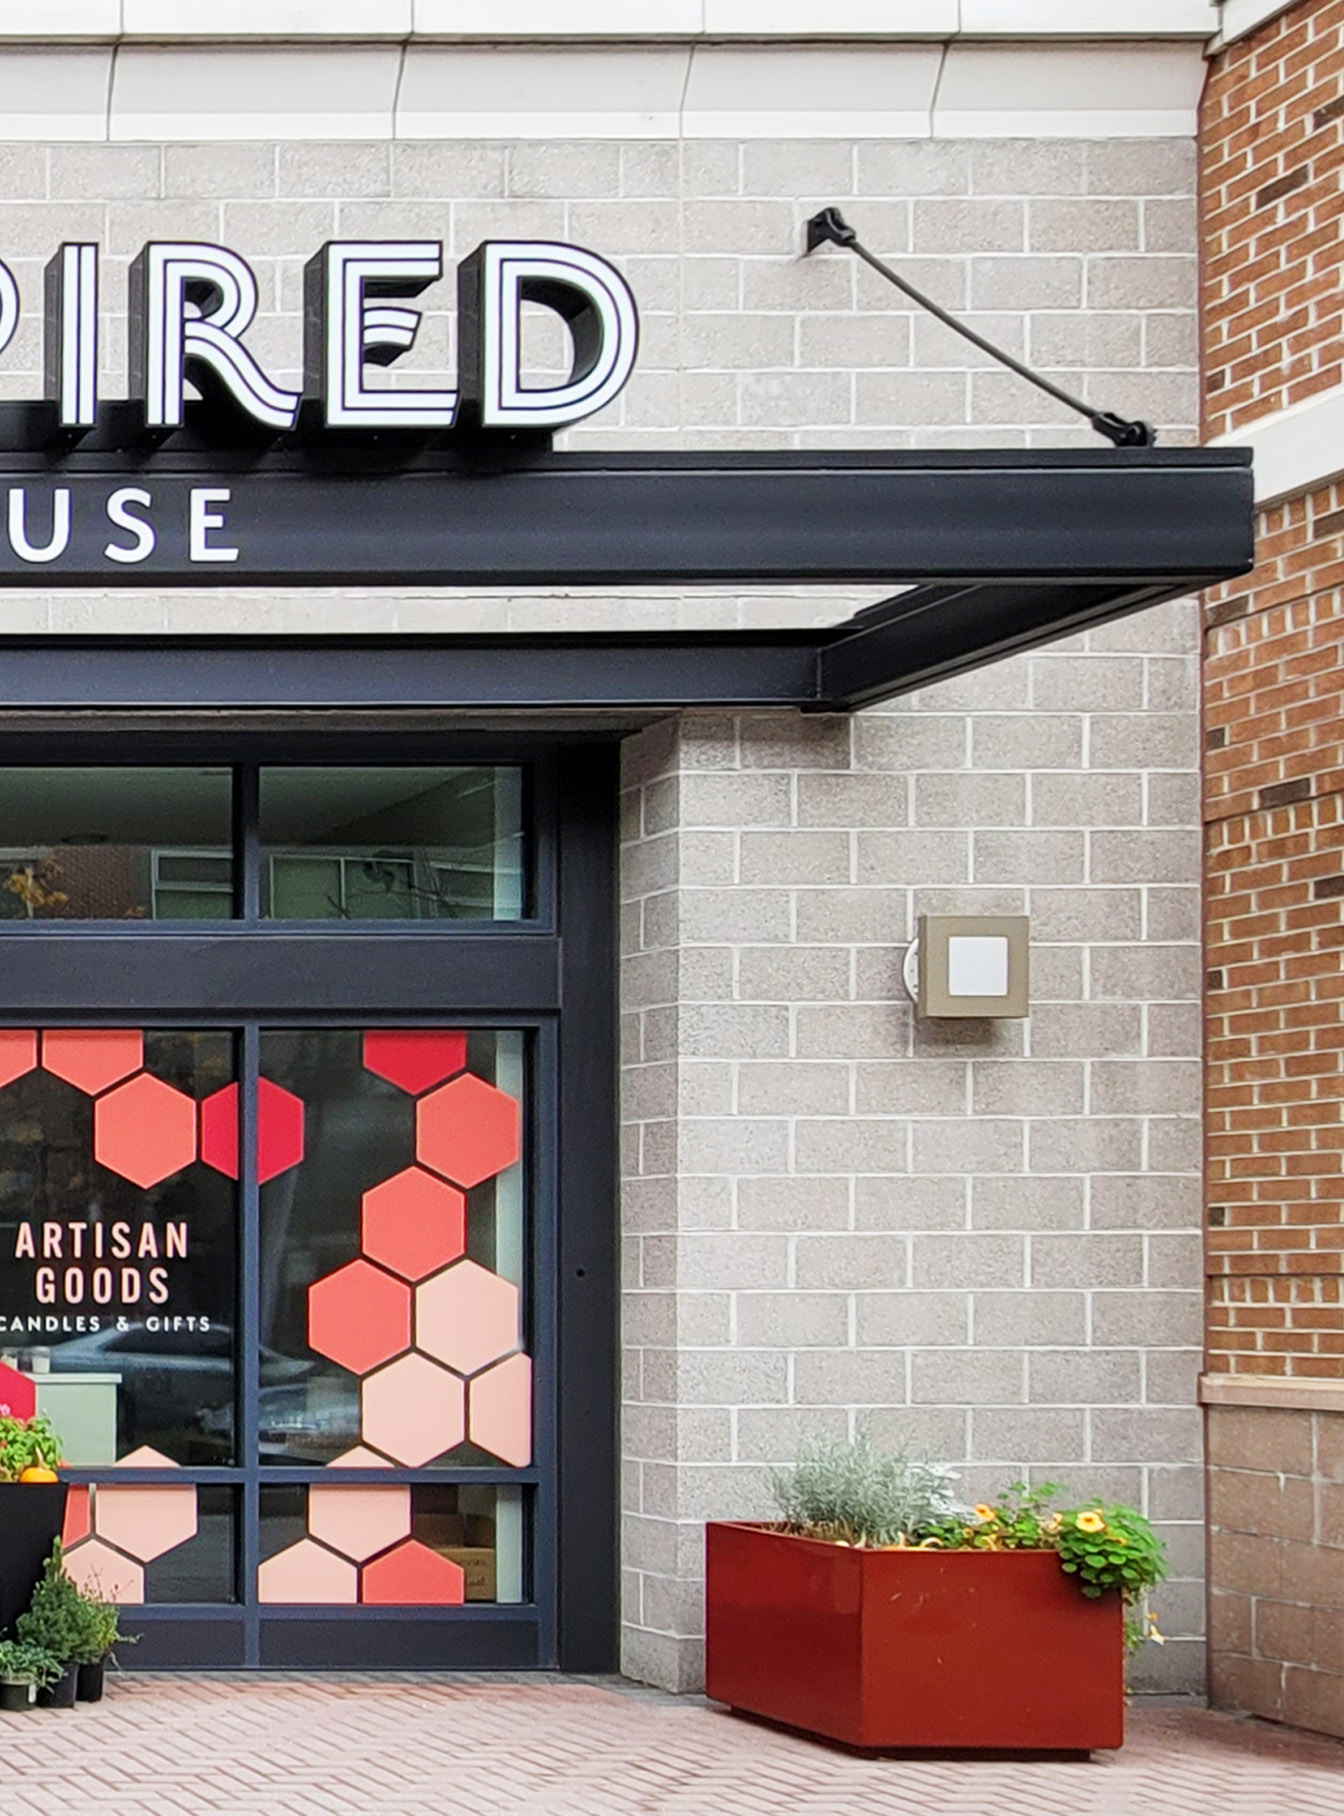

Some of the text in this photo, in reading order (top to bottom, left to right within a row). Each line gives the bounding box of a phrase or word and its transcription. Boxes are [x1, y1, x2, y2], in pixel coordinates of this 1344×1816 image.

[14, 1222, 188, 1259] ARTISAN
[35, 1267, 169, 1304] GOODS
[115, 1316, 130, 1332] &
[145, 1316, 211, 1332] GIFTS
